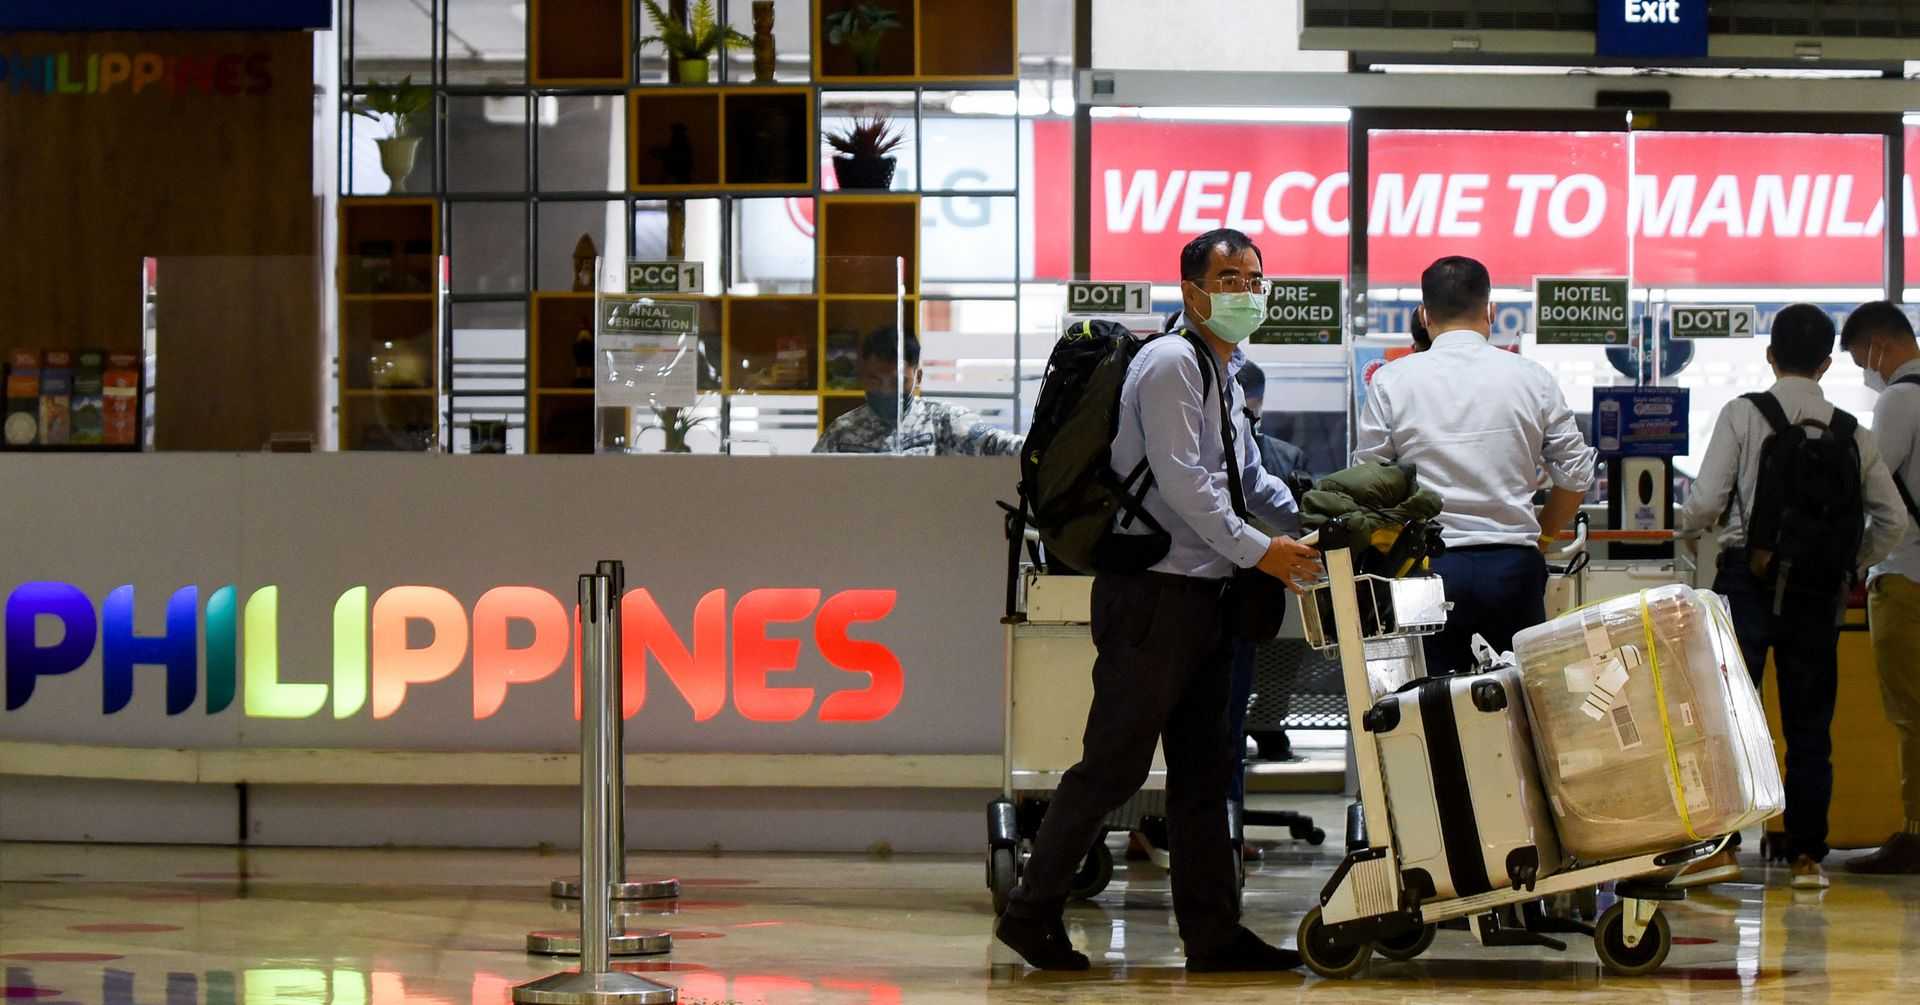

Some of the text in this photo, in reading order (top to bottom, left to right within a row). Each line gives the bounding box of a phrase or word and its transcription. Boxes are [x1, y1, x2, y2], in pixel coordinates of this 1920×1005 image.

[1625, 0, 1680, 23] Exit
[0, 52, 272, 96] HILIPPINES
[1104, 169, 1489, 238] WELCOME
[1507, 173, 1607, 239] TO
[629, 266, 696, 288] PCG 1
[1073, 286, 1142, 309] DOT 1
[1274, 286, 1317, 301] PRE-
[1554, 286, 1611, 301] HOTEL
[608, 318, 689, 329] ERIFICATION
[1265, 305, 1333, 321] OOKED
[1541, 305, 1624, 321] BOOKING
[1678, 311, 1728, 329] DOT
[1734, 312, 1749, 333] 2
[5, 581, 904, 723] PHILIPPNES
